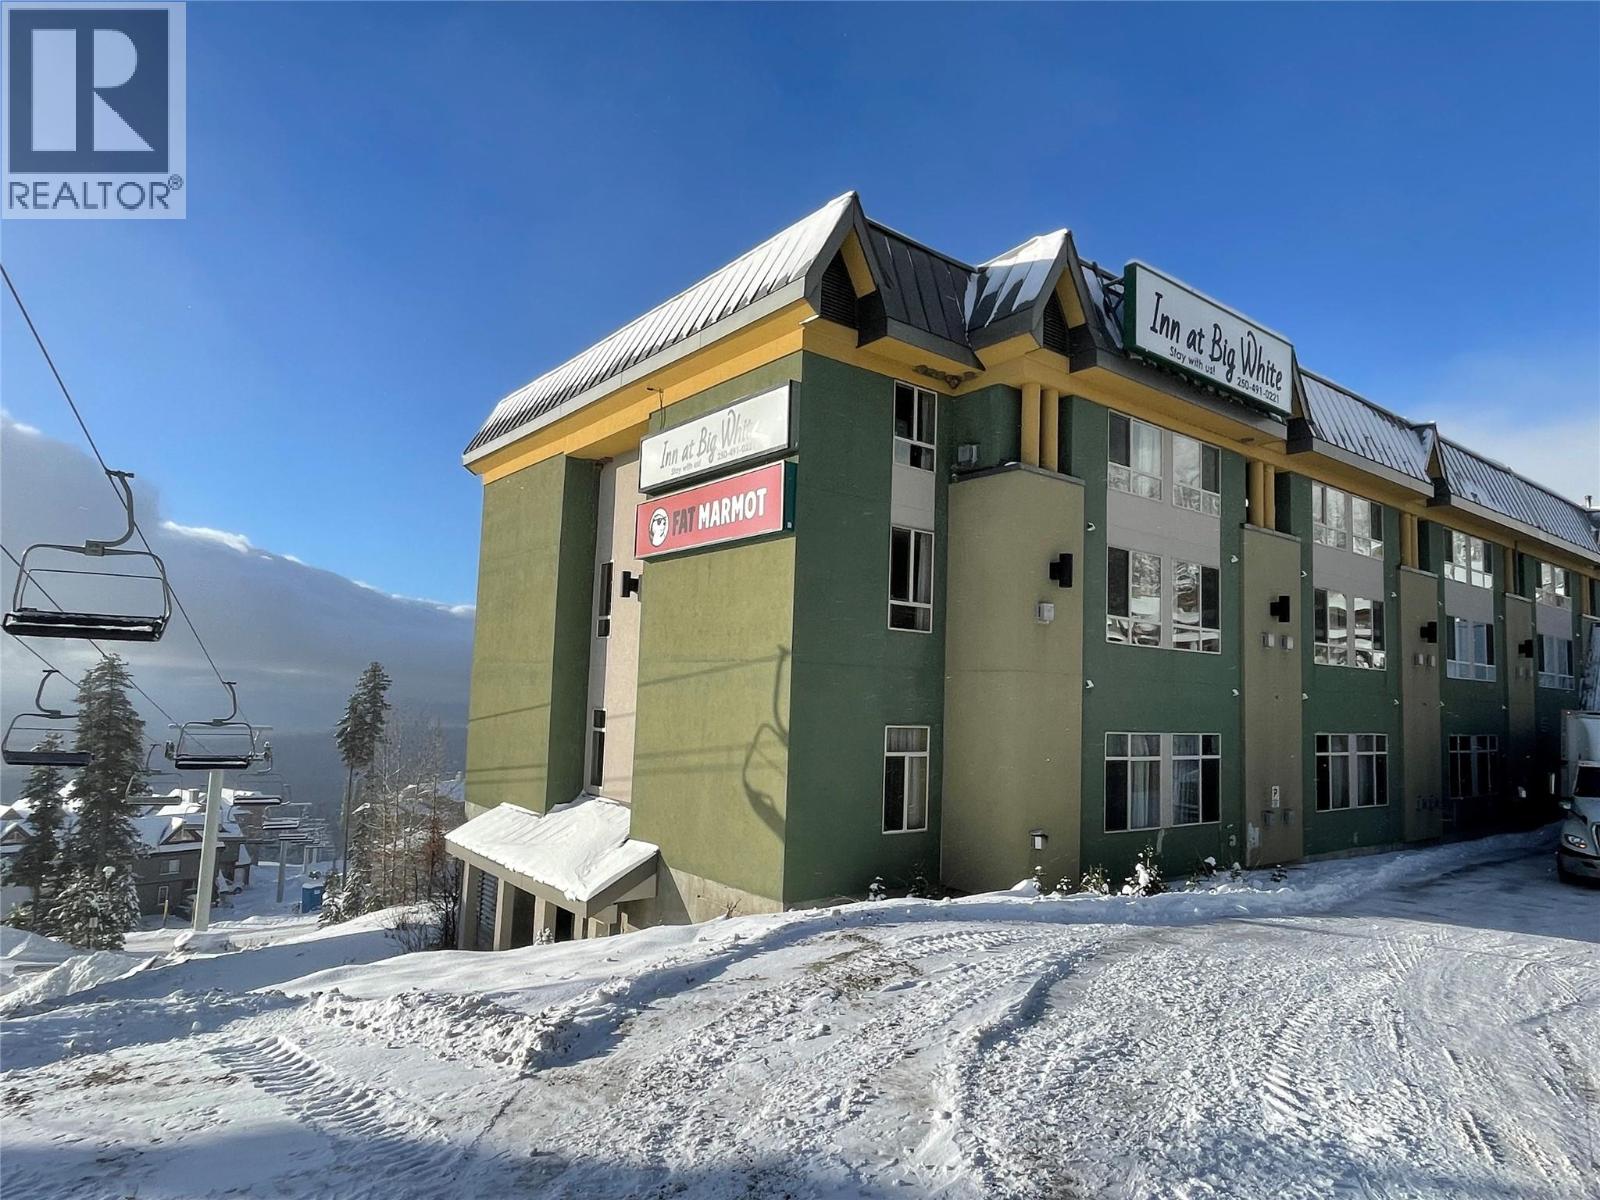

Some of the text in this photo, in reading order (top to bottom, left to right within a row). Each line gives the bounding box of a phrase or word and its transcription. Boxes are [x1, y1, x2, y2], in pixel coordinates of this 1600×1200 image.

[1150, 292, 1283, 391] Inn at Big White
[1169, 346, 1216, 375] Stay with us!
[1237, 376, 1280, 404] 250-491-0221
[660, 440, 679, 469] Inn
[681, 439, 695, 461] at
[696, 426, 717, 463] Big
[672, 487, 767, 537] FAT MARMOT
